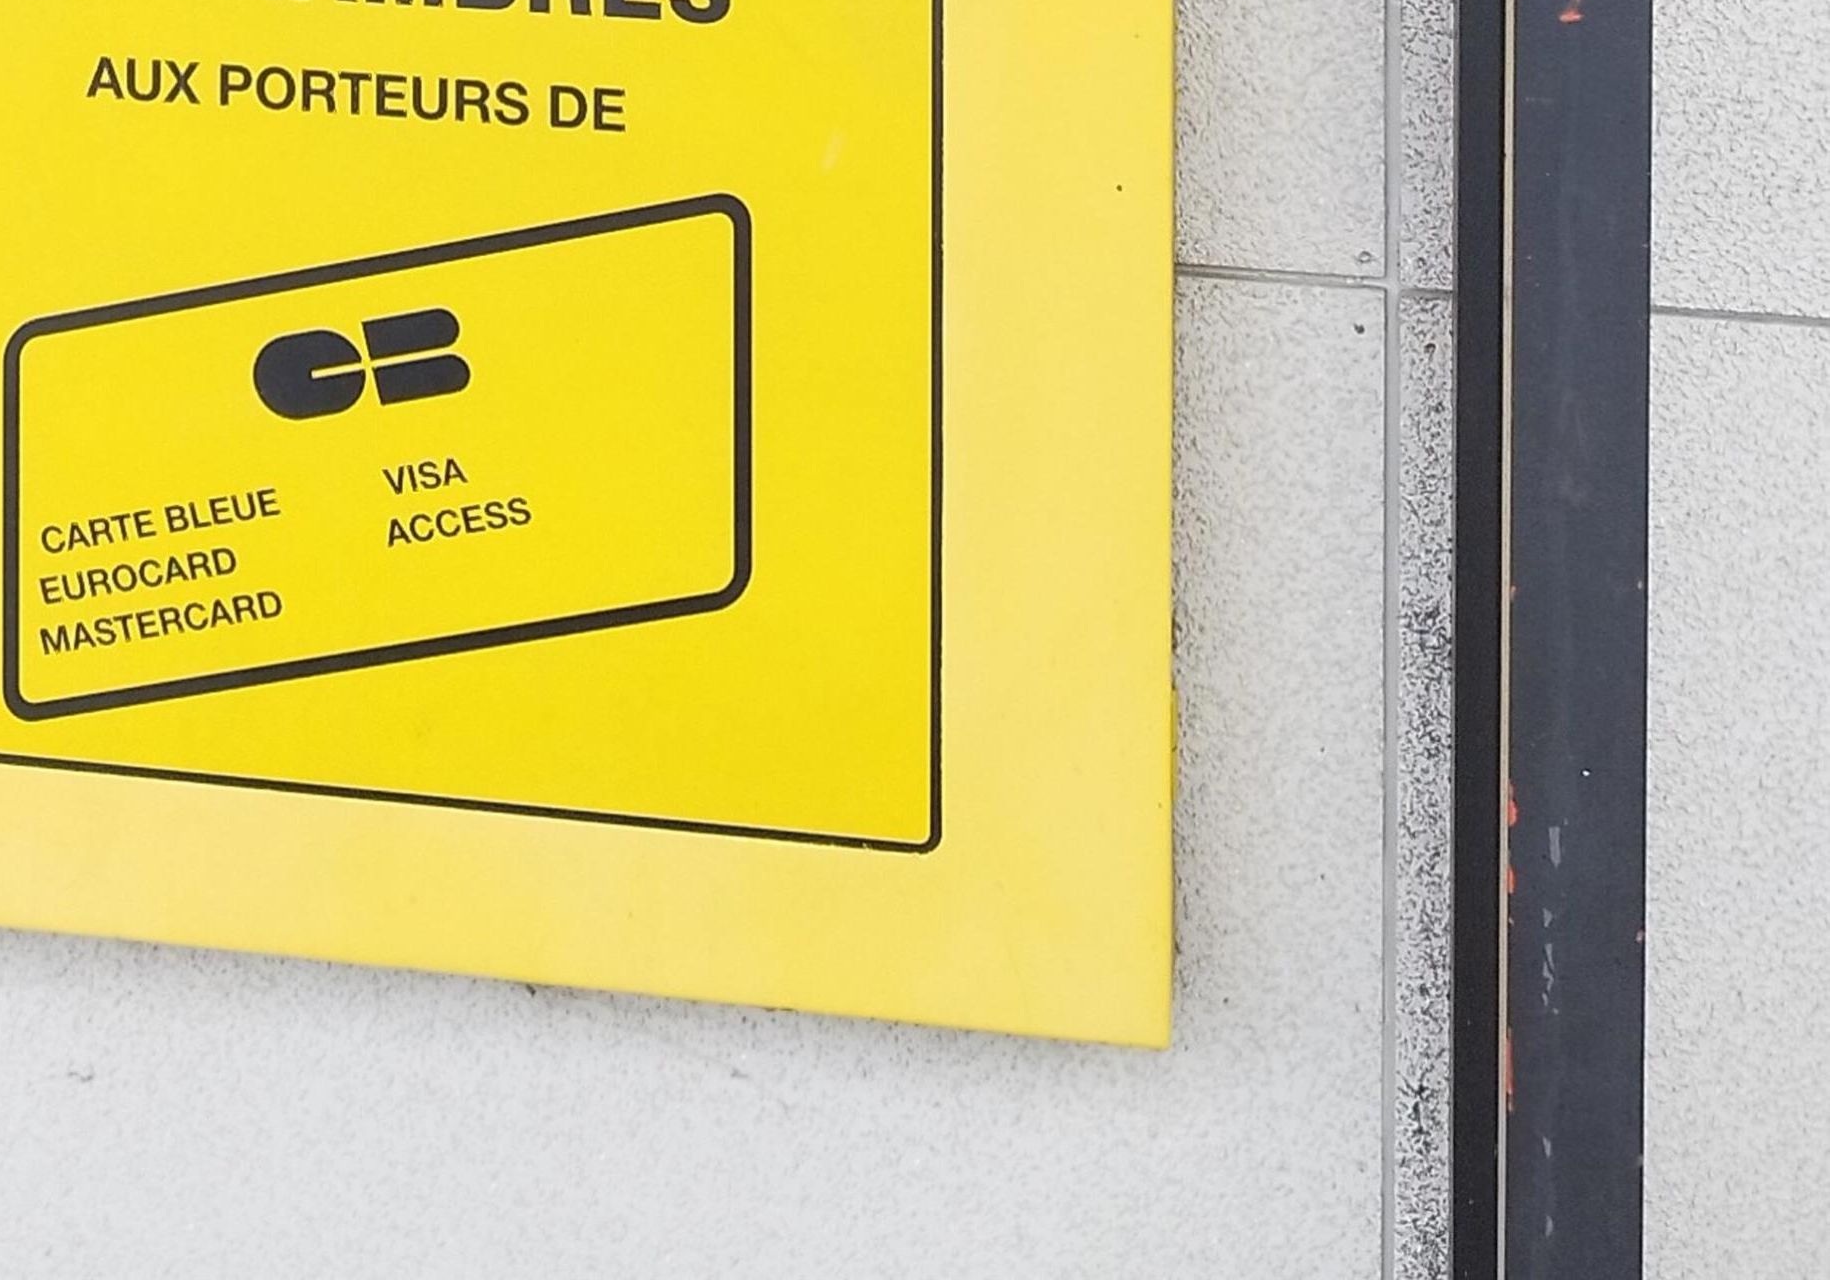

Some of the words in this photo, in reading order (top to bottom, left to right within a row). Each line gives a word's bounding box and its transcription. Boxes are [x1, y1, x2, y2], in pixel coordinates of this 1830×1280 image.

[87, 56, 200, 104] AUX
[220, 64, 530, 126] PORTEURS
[550, 85, 626, 132] DE
[382, 458, 468, 496] VISA
[40, 510, 157, 555] CARTE
[164, 487, 282, 534] BLEUE
[388, 496, 533, 548] ACCESS
[39, 547, 238, 606] EUROCARD
[39, 590, 283, 656] MASTERCARD
